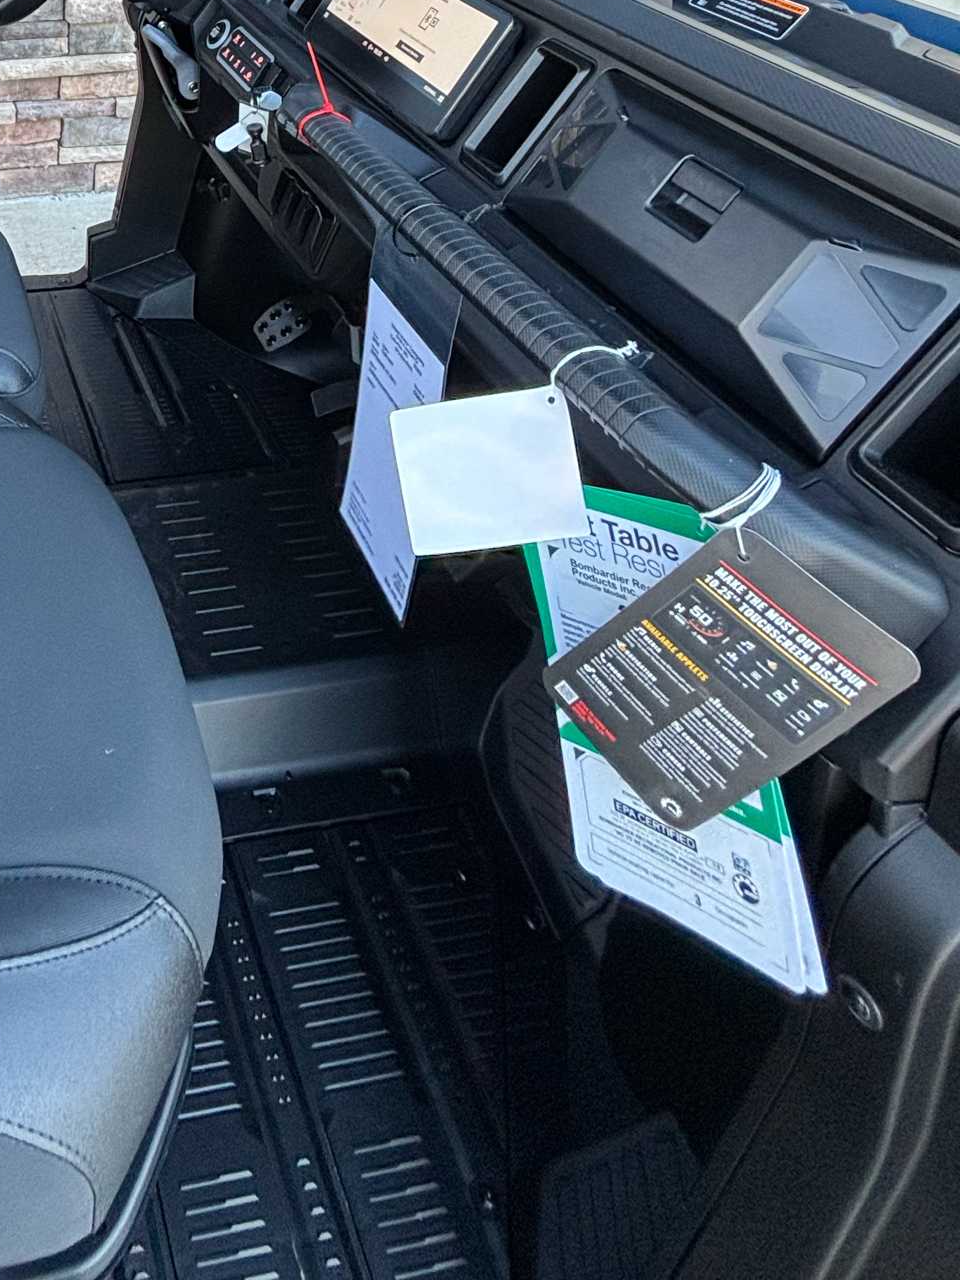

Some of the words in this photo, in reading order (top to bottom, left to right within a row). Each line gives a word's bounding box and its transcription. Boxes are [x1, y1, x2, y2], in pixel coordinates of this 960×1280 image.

[600, 518, 679, 562] Table
[570, 558, 630, 585] Bombardier
[572, 568, 618, 591] Products
[576, 578, 602, 591] Vehicle
[643, 633, 662, 654] MEDIA
[714, 567, 747, 595] MAKE
[744, 589, 768, 612] THE
[764, 606, 799, 638] MOST
[795, 632, 822, 653] OUT
[817, 649, 837, 667] OF
[834, 662, 867, 690] YOUR
[641, 619, 679, 654] AVAILABLE
[675, 649, 709, 682] APPLETS
[738, 602, 813, 665] TOUCHSCREEN
[809, 661, 858, 700] DISPLAY
[607, 661, 625, 681] PHONE
[624, 650, 658, 682] NAVIGATION
[591, 671, 613, 696] VEHICLE
[718, 703, 755, 739] STATISTICS
[681, 731, 712, 761] CONTROLS
[702, 718, 743, 755] PREFERENCES
[662, 748, 686, 772] CAMERA
[615, 801, 638, 819] EPA
[637, 811, 696, 849] CERTIFIED
[694, 893, 701, 907] 3
